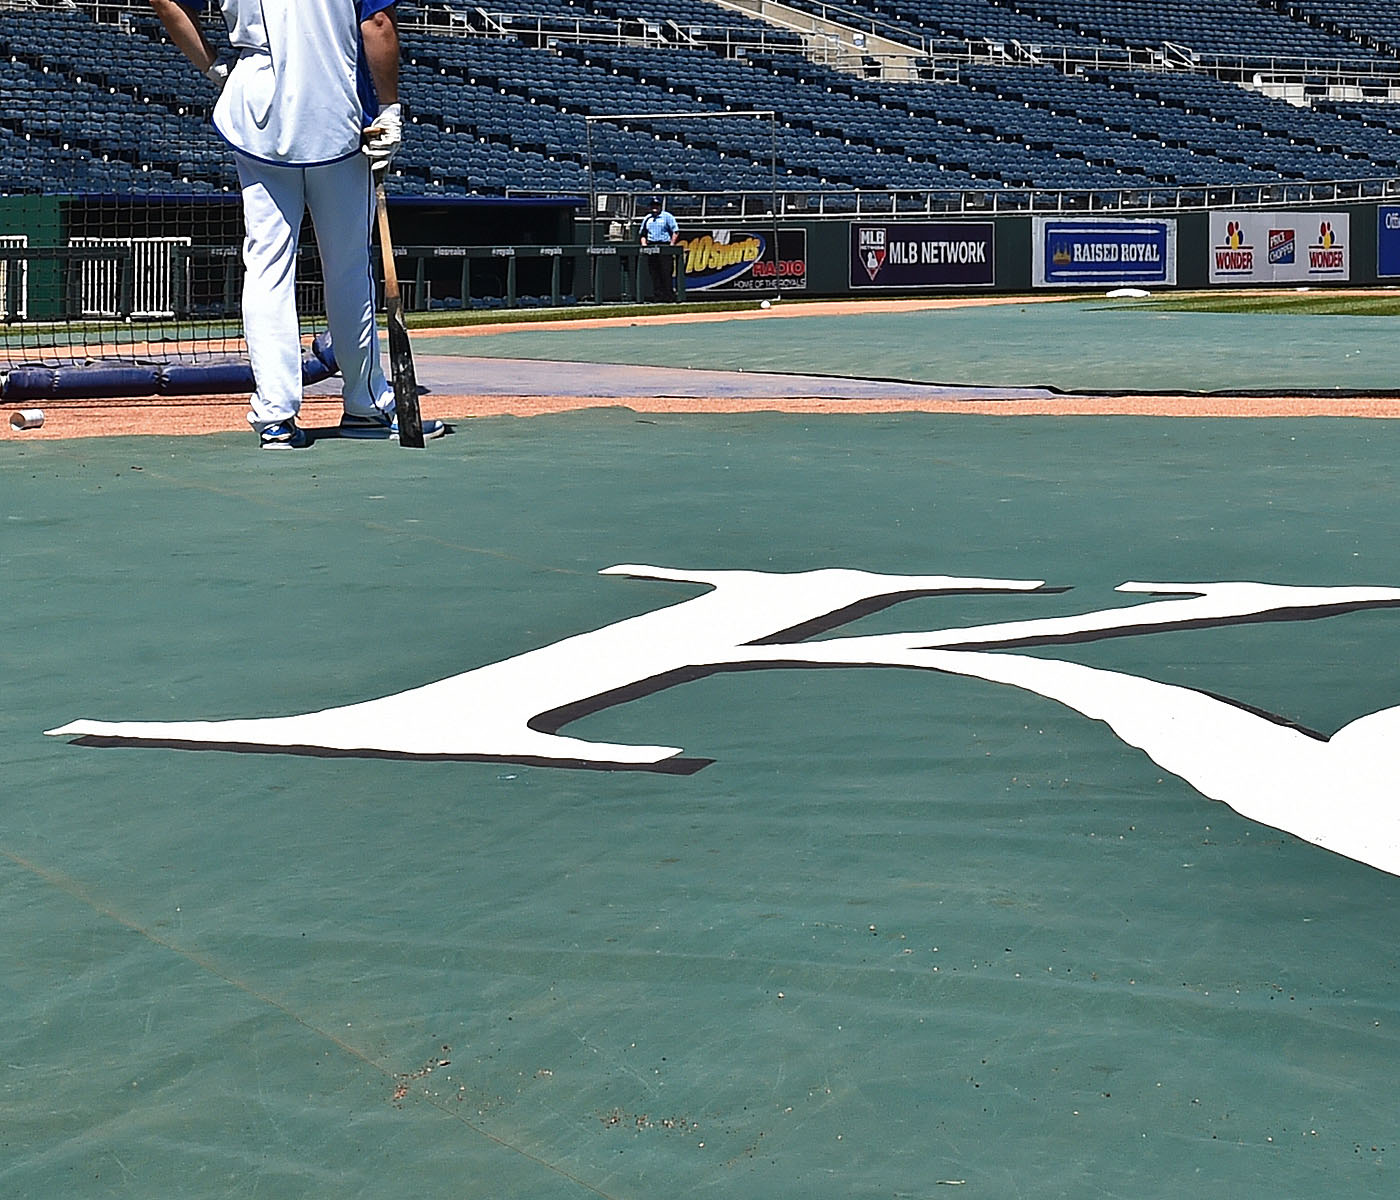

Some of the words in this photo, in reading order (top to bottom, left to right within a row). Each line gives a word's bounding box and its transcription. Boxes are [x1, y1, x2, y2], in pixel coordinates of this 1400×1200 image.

[860, 231, 885, 245] MLB
[889, 242, 918, 264] MLB
[921, 241, 986, 264] NETWORK
[1073, 243, 1118, 262] RAISED
[1121, 243, 1160, 262] ROYAL
[1215, 252, 1253, 269] WONDER
[1309, 251, 1343, 268] WONDER
[753, 260, 805, 277] RADIO
